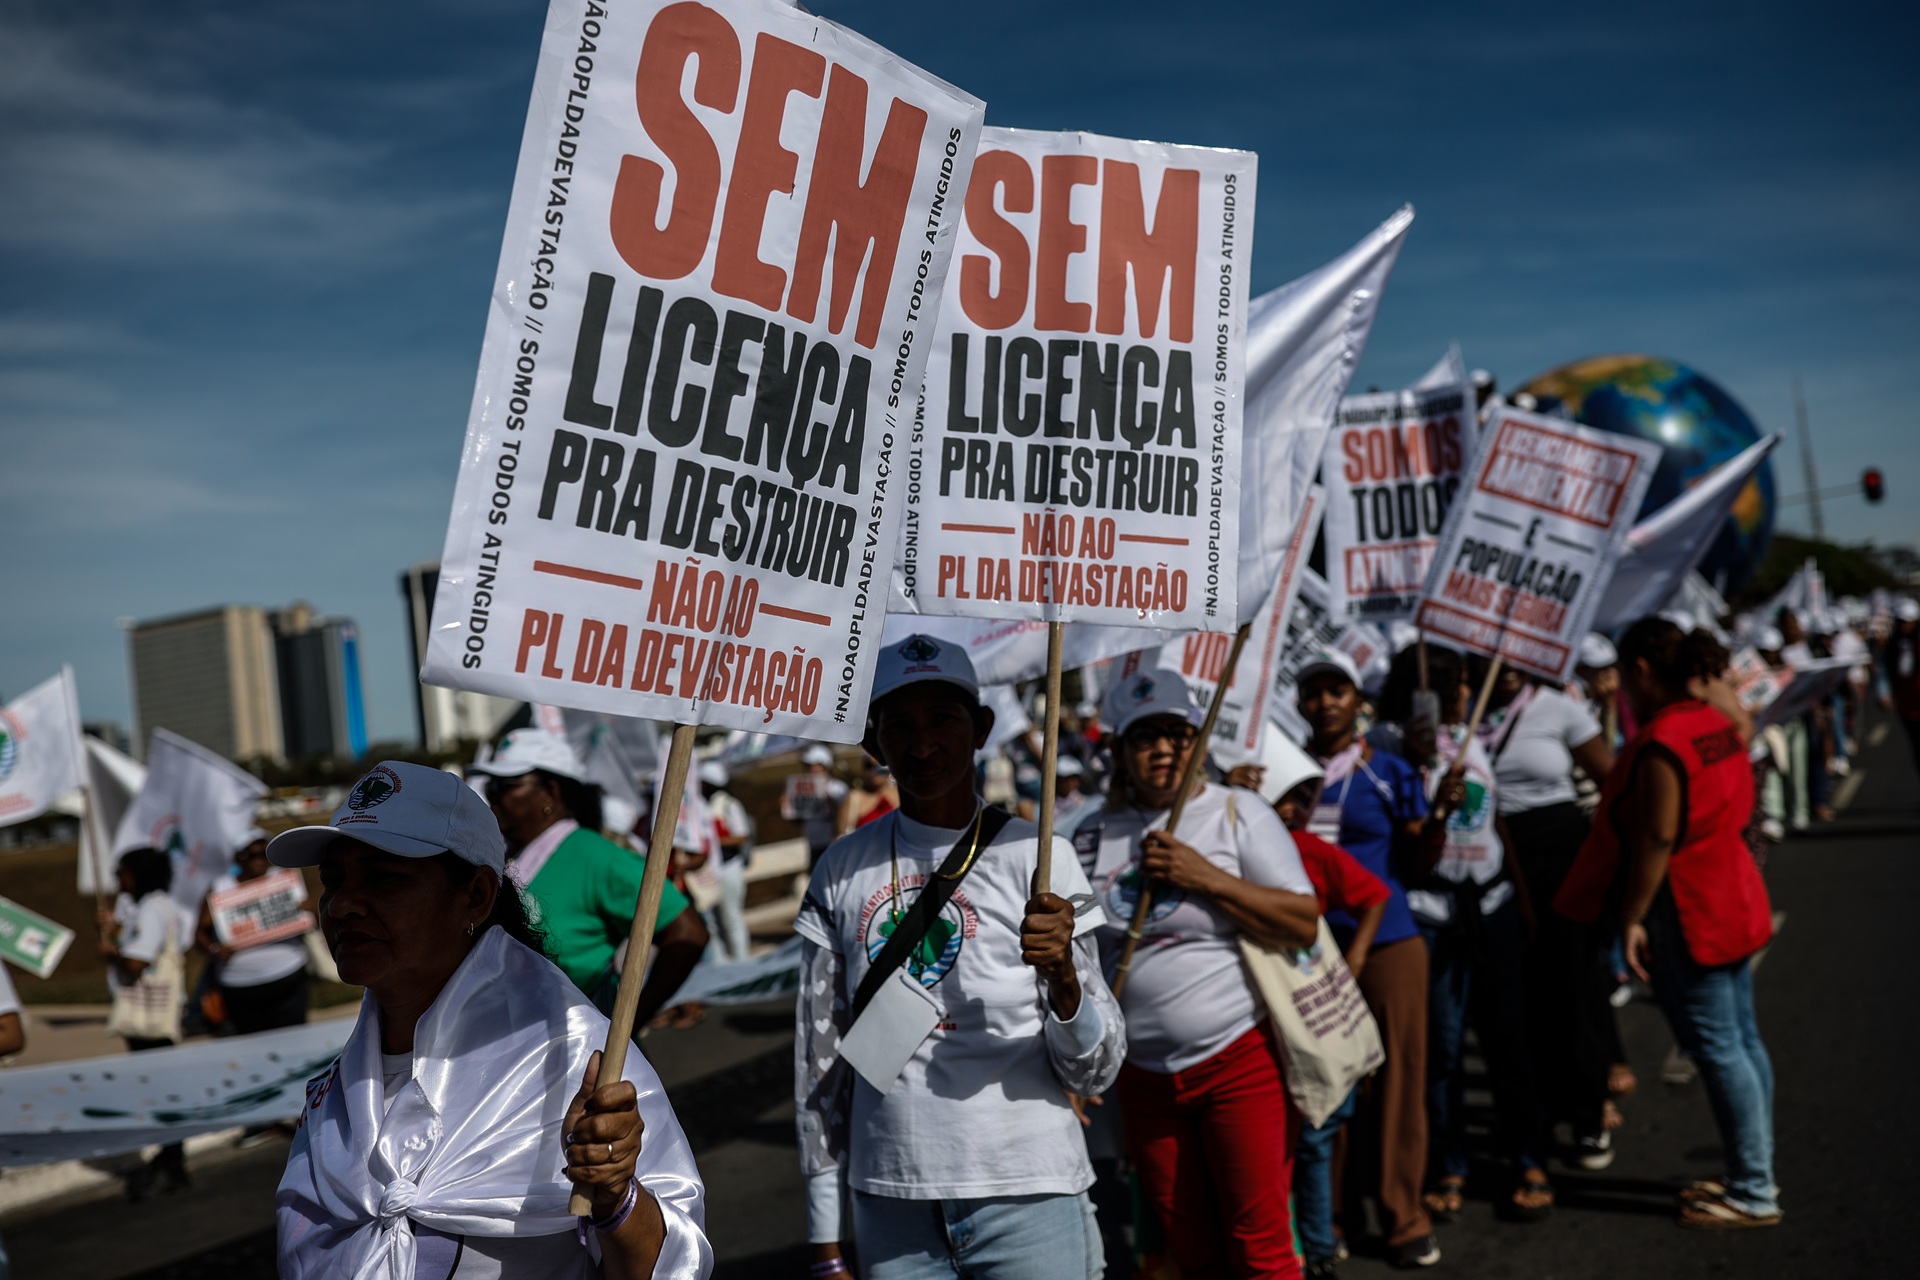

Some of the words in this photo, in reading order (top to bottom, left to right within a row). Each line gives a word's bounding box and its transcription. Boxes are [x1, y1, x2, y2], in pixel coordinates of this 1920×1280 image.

[528, 0, 608, 310] ÃOAOPLDADEVASTAÇÃO
[609, 1, 928, 350] SEM
[959, 149, 1200, 343] SEM
[1220, 174, 1237, 259] ATINGIDOS
[1218, 264, 1232, 319] TODOS
[506, 339, 539, 430] SOMOS
[563, 271, 872, 495] LICENÇA
[947, 333, 1197, 451] LICENÇA
[1214, 323, 1229, 382] SOMOS
[834, 432, 894, 724] #NÃOAOPLDADEVASTAÇÃO
[888, 330, 913, 408] SOMOS
[906, 250, 932, 322] TODOS
[925, 127, 961, 244] ATINGIDOS
[1342, 416, 1462, 484] SOMOS
[488, 440, 521, 525] TODOS
[538, 429, 657, 541] PRA
[660, 458, 858, 588] DESTRUIR
[906, 451, 922, 504] TODOS
[939, 437, 1015, 501] PRA
[1024, 443, 1199, 517] DESTRUIR
[1205, 400, 1226, 617] #NÃOAOPLDADEVASTAÇÃO
[904, 510, 919, 598] ATINGIDOS
[1021, 508, 1075, 557] NÃO
[1078, 516, 1115, 560] AO
[1454, 536, 1582, 604] POPULAÇÃO
[463, 533, 503, 669] ATINGIDOS
[646, 557, 724, 633] NÃO
[721, 576, 759, 639] AO
[938, 555, 970, 599] PL
[976, 557, 1011, 601] DA
[1018, 560, 1188, 620] DEVASTAÇÃO
[515, 608, 564, 679] PL
[572, 619, 628, 688] DA
[631, 629, 822, 723] DEVASTAÇÃO
[856, 890, 885, 942] MOVIMENTO
